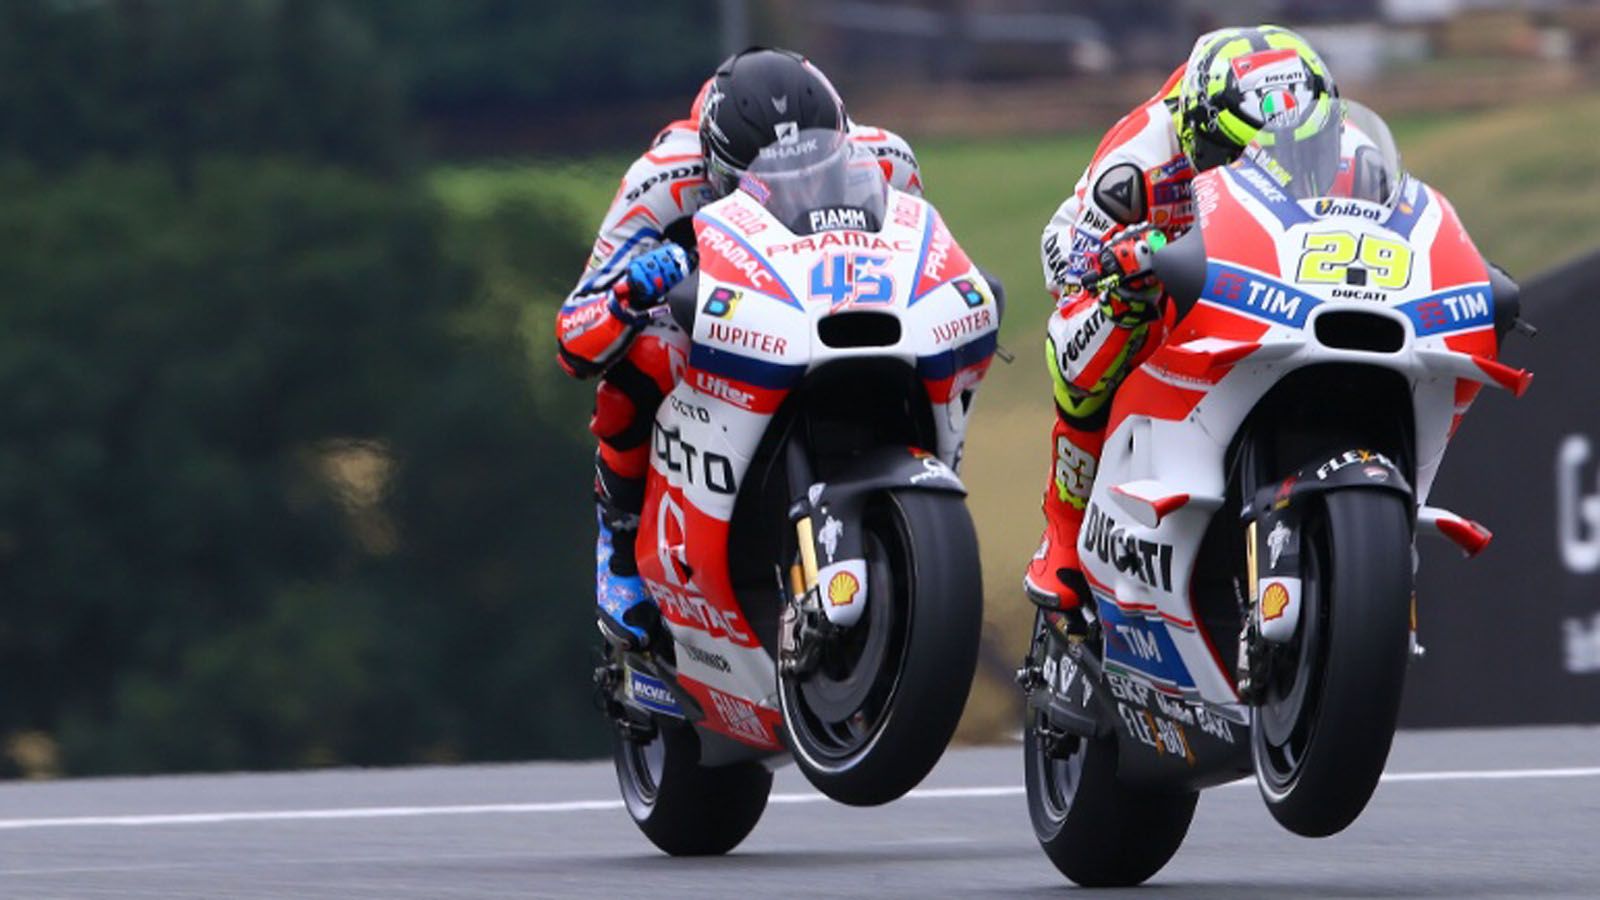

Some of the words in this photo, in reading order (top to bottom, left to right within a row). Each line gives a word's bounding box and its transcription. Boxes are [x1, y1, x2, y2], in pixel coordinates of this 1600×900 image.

[758, 138, 818, 160] SHARK
[809, 208, 867, 232] FIAMM
[700, 225, 773, 288] PRAMAC
[766, 230, 913, 258] PRAMAC
[1294, 230, 1414, 290] 29
[807, 251, 896, 309] 45
[1331, 288, 1387, 302] DUCATI
[1247, 280, 1301, 320] TIM
[1442, 292, 1489, 321] TIM
[708, 322, 787, 356] JUPITER
[932, 309, 991, 345] JUPITER
[696, 372, 756, 405] Lifter
[1085, 502, 1174, 593] DUCATI
[1116, 624, 1163, 663] TIM
